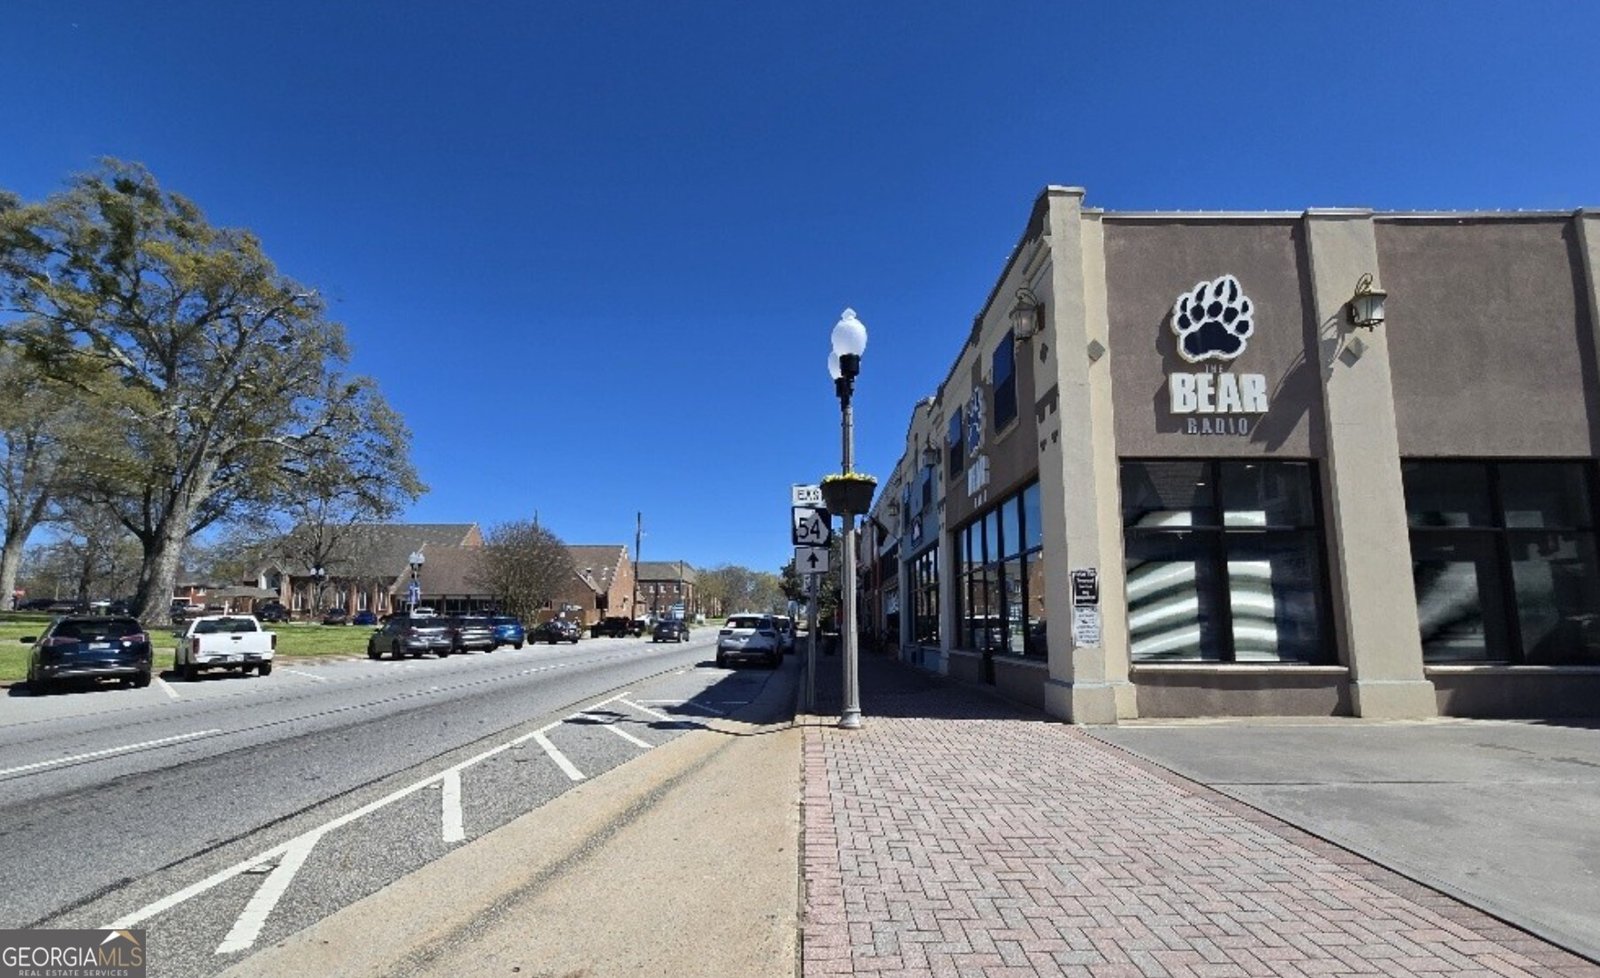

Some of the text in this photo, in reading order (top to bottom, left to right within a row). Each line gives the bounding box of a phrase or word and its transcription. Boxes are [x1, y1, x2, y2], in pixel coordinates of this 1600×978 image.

[1205, 364, 1223, 373] THE
[1170, 373, 1269, 413] BEAR
[1187, 417, 1248, 435] RADIO
[798, 490, 823, 500] EAS
[799, 517, 820, 539] 54
